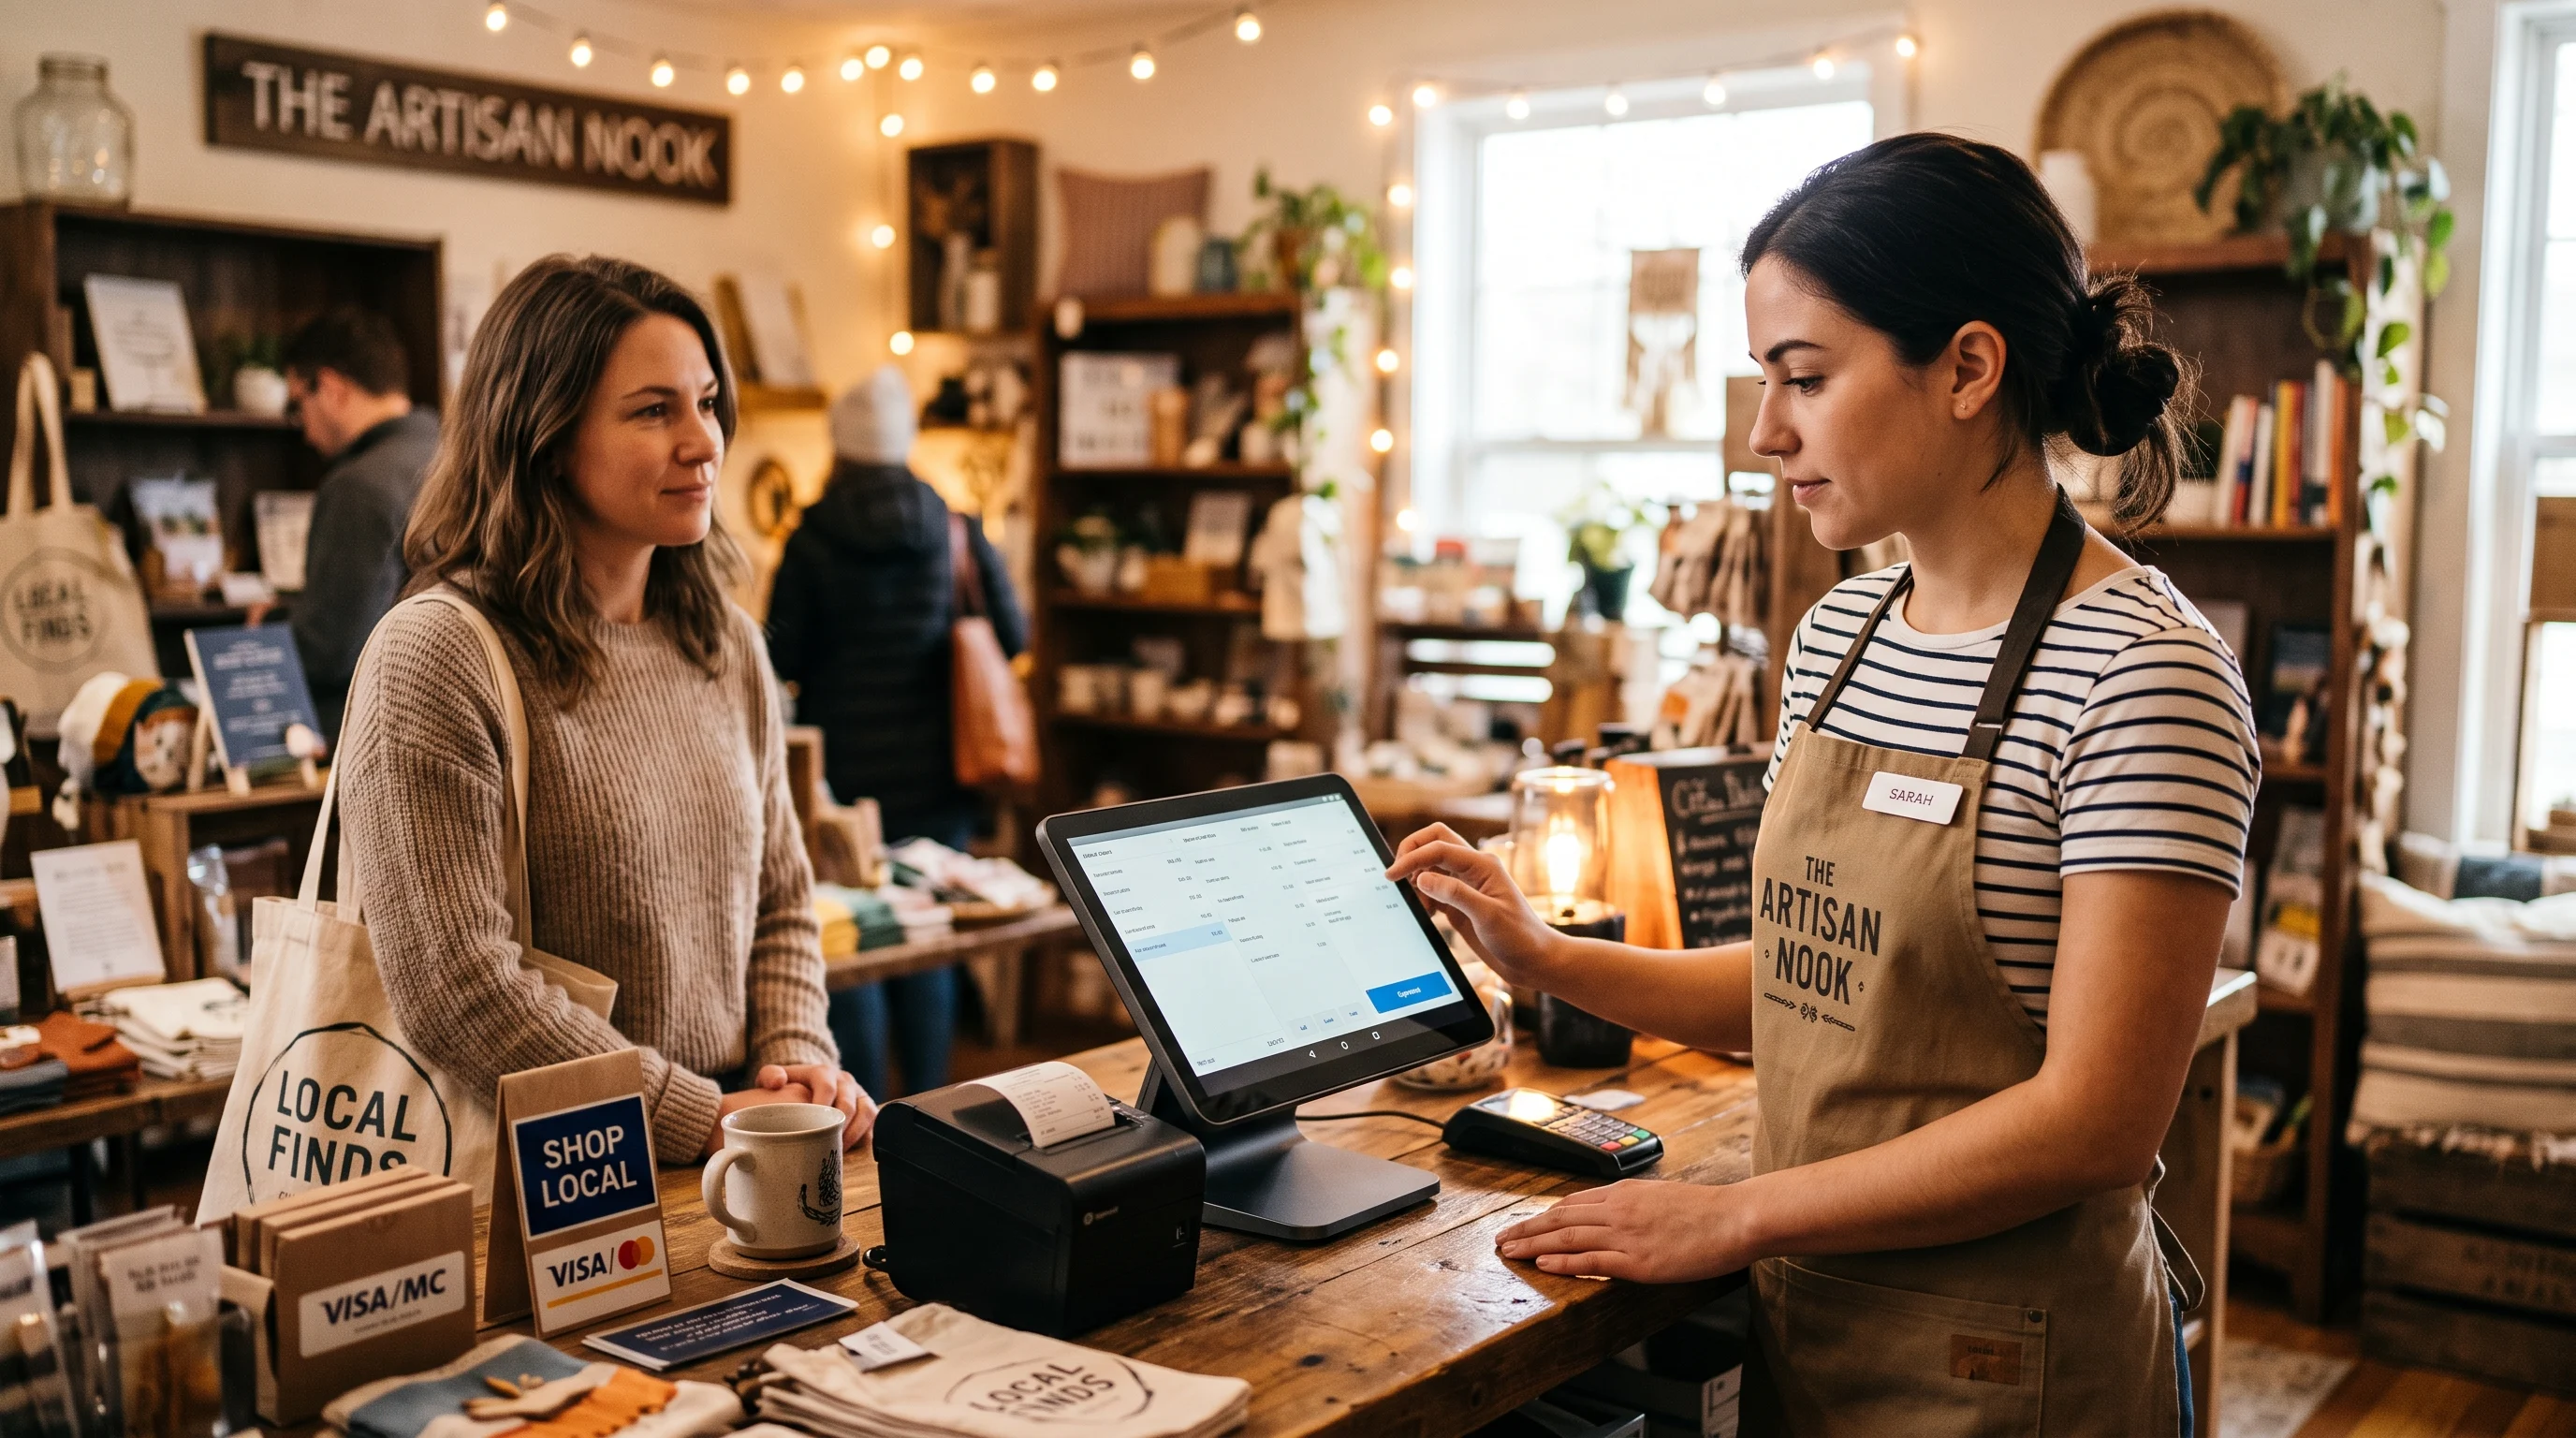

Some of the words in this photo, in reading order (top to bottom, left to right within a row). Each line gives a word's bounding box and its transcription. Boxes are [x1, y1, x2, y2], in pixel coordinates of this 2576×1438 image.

[242, 61, 353, 142] THE
[363, 81, 575, 171] ARTISAN
[583, 109, 719, 187] NOOK
[1889, 788, 1935, 806] SARAH
[1806, 856, 1836, 888] THE
[1760, 877, 1881, 956] ARTISAN
[1775, 936, 1853, 1005] NOOK
[277, 1070, 417, 1142] LOCAL
[543, 1125, 624, 1168] SHOP
[541, 1160, 637, 1209] LOCAL
[320, 1268, 446, 1325] VISA/MC
[968, 1363, 1084, 1413] LOCAL
